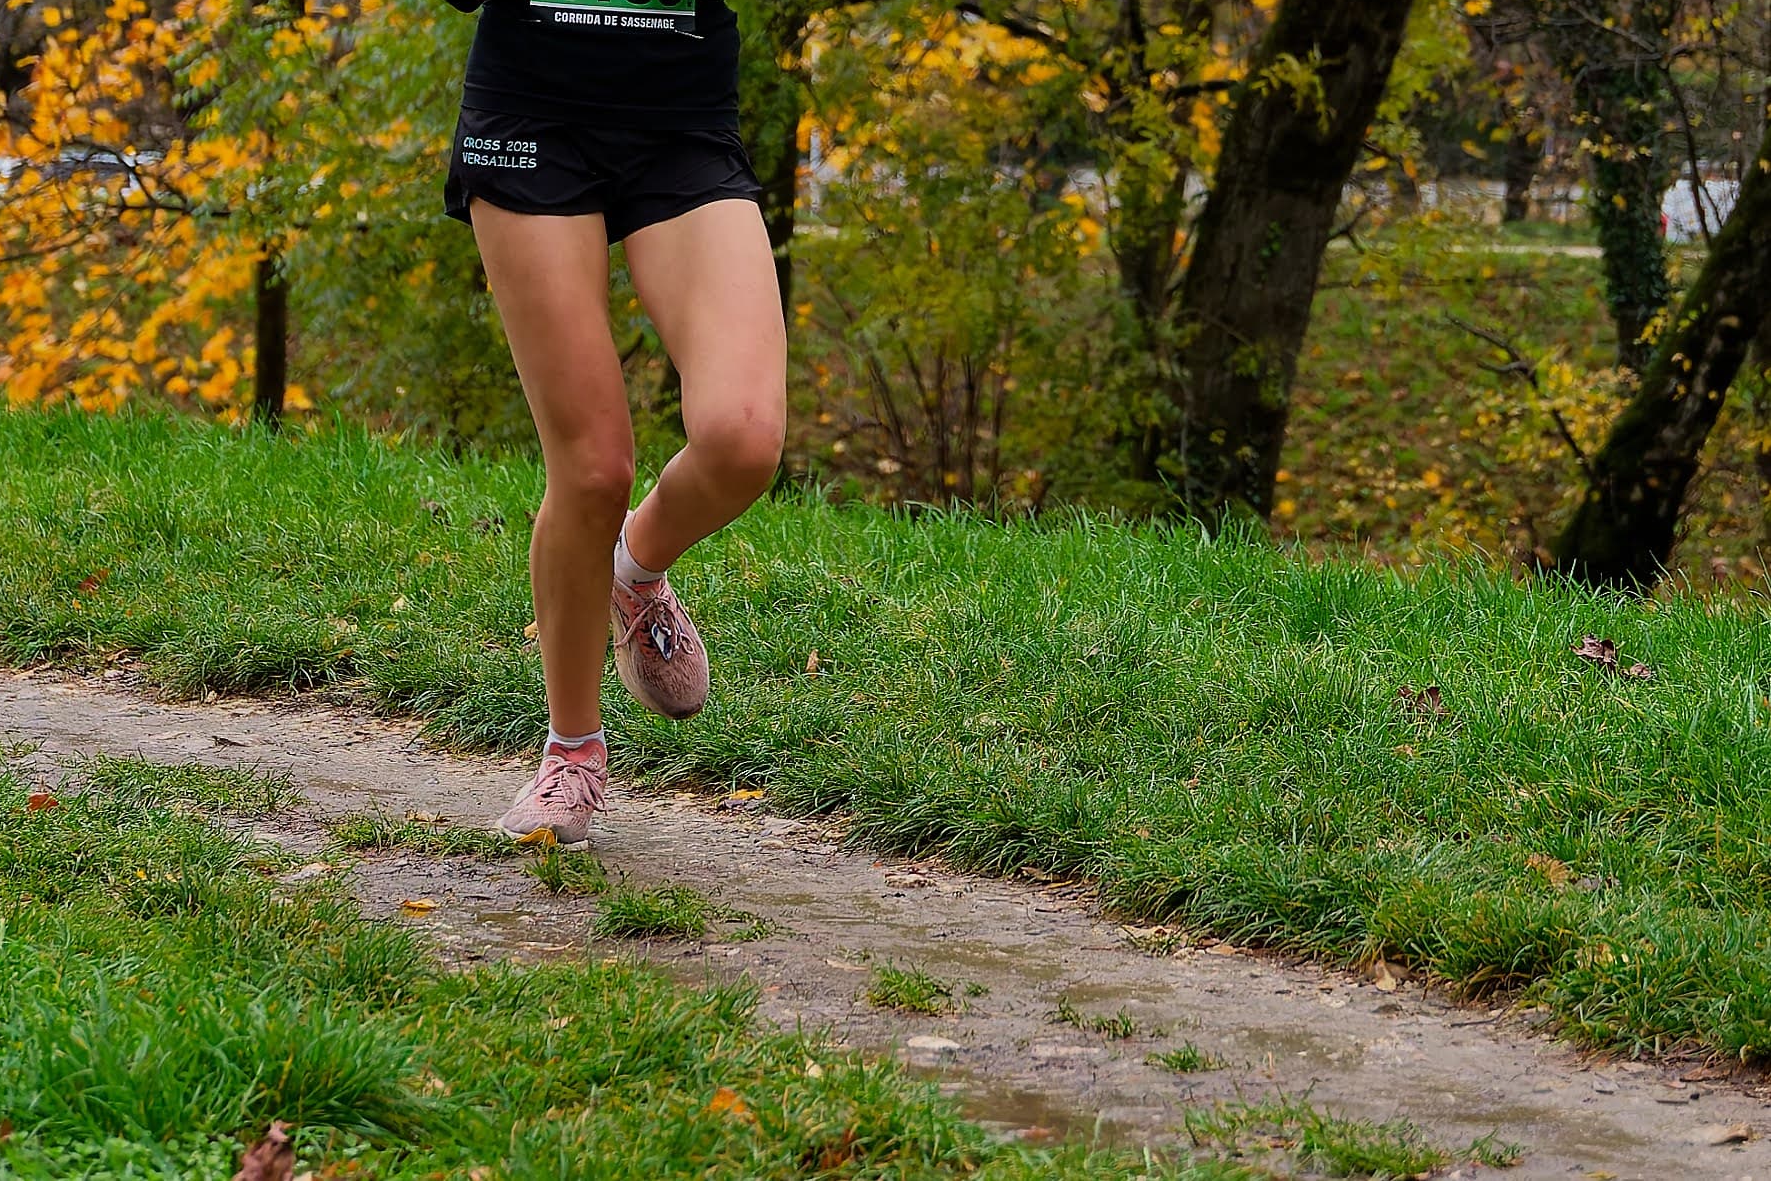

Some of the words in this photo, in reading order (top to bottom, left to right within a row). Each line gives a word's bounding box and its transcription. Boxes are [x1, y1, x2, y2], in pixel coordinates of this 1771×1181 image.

[554, 11, 601, 25] CORRIDA
[604, 15, 618, 26] DE
[620, 16, 675, 30] SASSENAGE
[463, 137, 501, 151] CROSS
[506, 140, 537, 153] 2025
[462, 152, 537, 168] VERSAILLES
